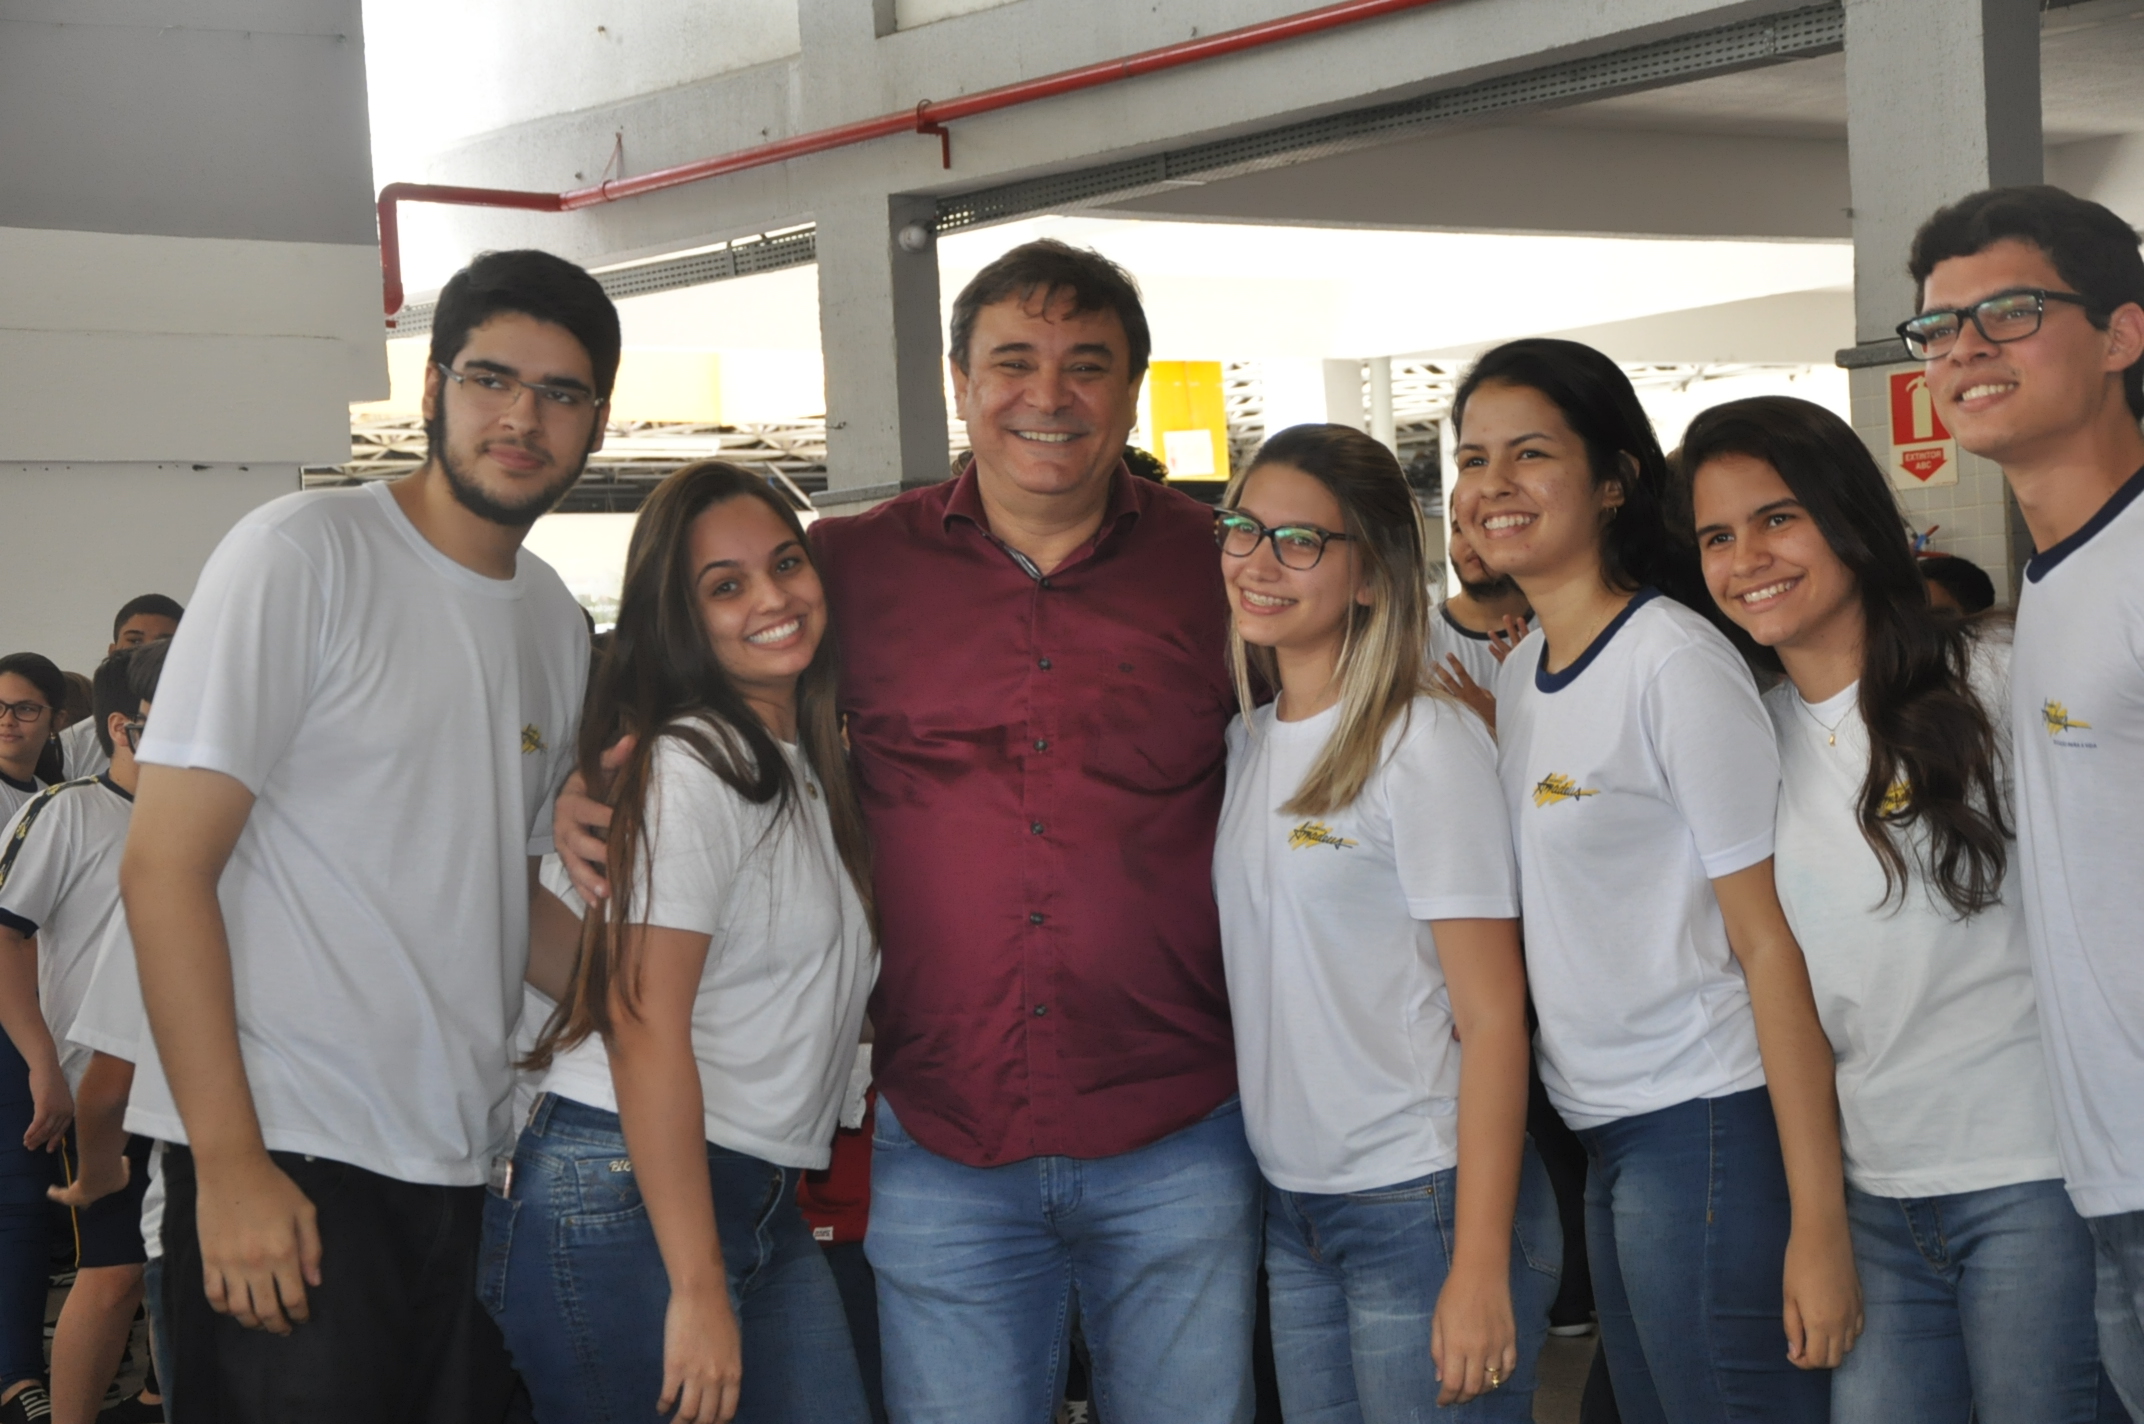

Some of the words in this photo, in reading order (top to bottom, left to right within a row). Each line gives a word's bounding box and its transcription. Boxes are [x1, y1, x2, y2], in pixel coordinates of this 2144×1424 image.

[1904, 450, 1942, 462] EXTINTOR
[1915, 460, 1932, 470] ABC
[1532, 772, 1593, 802] Amadeus
[1288, 821, 1354, 851] Amadeus
